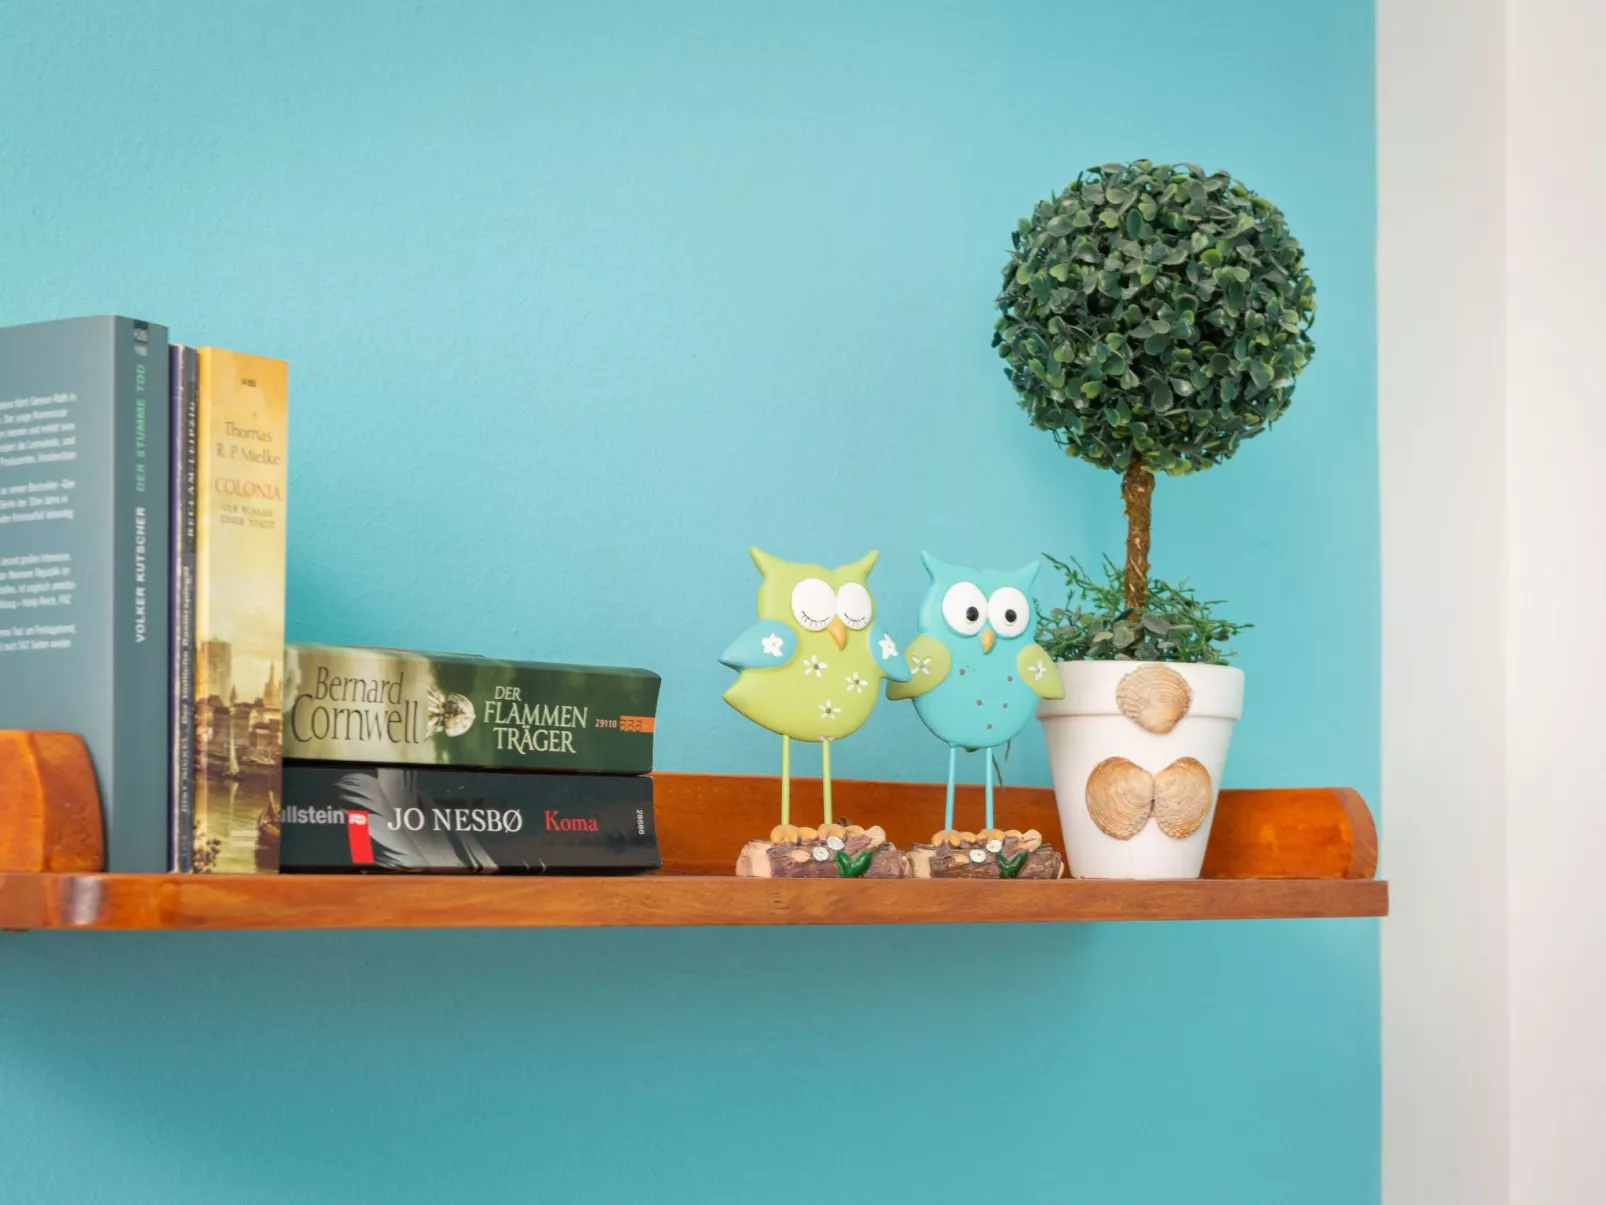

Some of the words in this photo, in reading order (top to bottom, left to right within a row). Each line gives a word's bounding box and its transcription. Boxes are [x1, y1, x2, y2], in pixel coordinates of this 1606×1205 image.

[135, 364, 146, 392] TOD
[135, 398, 146, 458] STUMME
[224, 421, 273, 443] Thomas
[135, 464, 146, 492] DER
[214, 476, 282, 501] COLONIA
[135, 507, 146, 582] KUTSCHER
[135, 588, 146, 643] VOLKER
[314, 666, 405, 705] Bernard
[494, 685, 523, 702] DER
[291, 693, 420, 745] Cornwell
[483, 700, 589, 729] FLAMMEN
[595, 718, 618, 729] 29110
[492, 723, 577, 755] TRÄGER
[387, 807, 426, 832] JO
[432, 808, 523, 834] NESBØ
[544, 809, 600, 832] Koma
